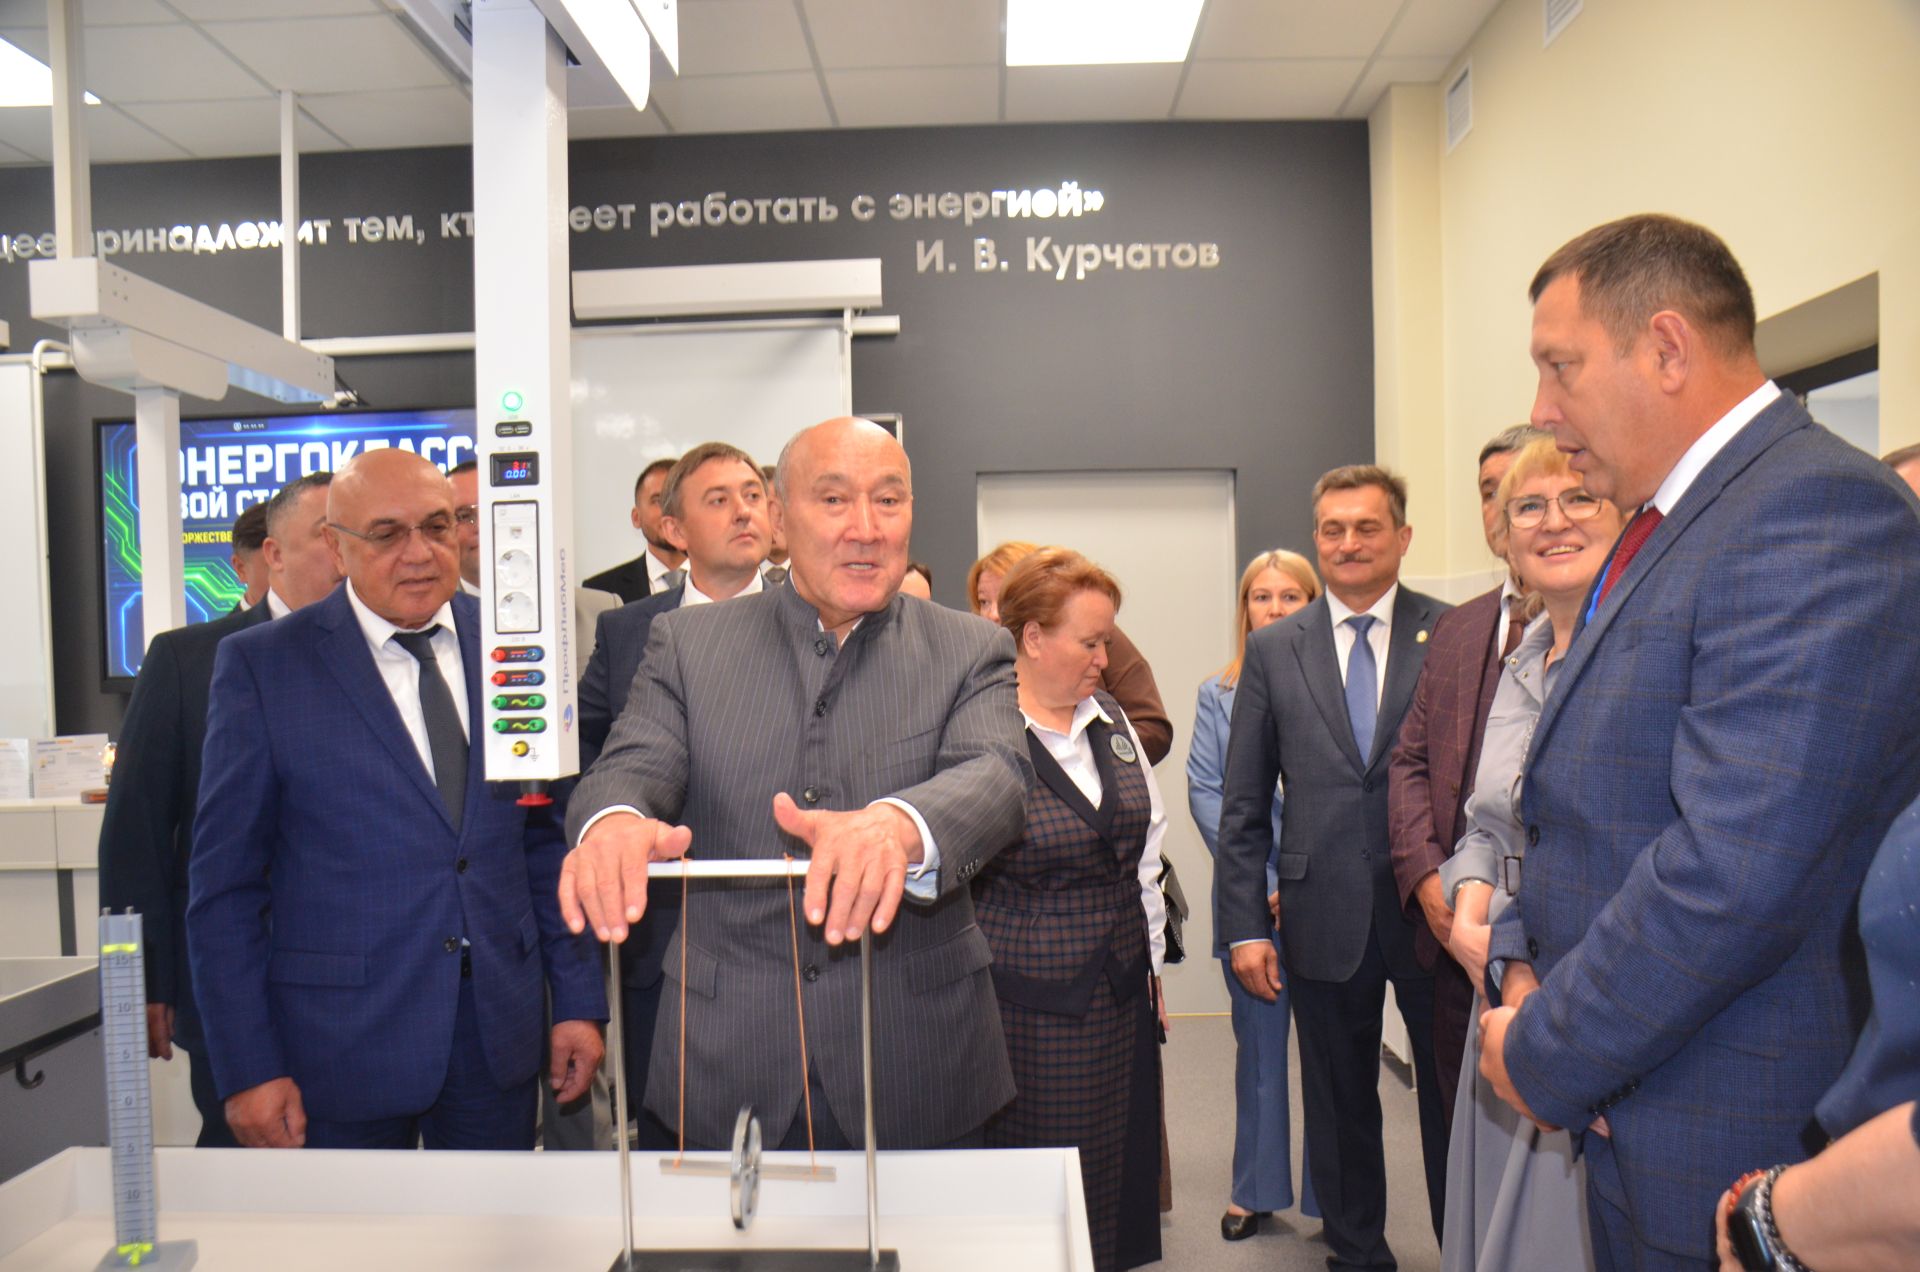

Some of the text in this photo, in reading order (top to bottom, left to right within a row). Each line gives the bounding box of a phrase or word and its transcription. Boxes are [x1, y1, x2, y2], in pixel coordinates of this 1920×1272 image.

[91, 218, 331, 262] ринадлежит
[343, 215, 425, 246] тем,
[650, 192, 838, 237] работать
[851, 195, 876, 222] с
[916, 236, 1220, 281] И. В. Курчатов
[180, 435, 478, 486] НЕРГОКСС
[236, 488, 280, 517] СТ
[117, 1002, 131, 1013] 10
